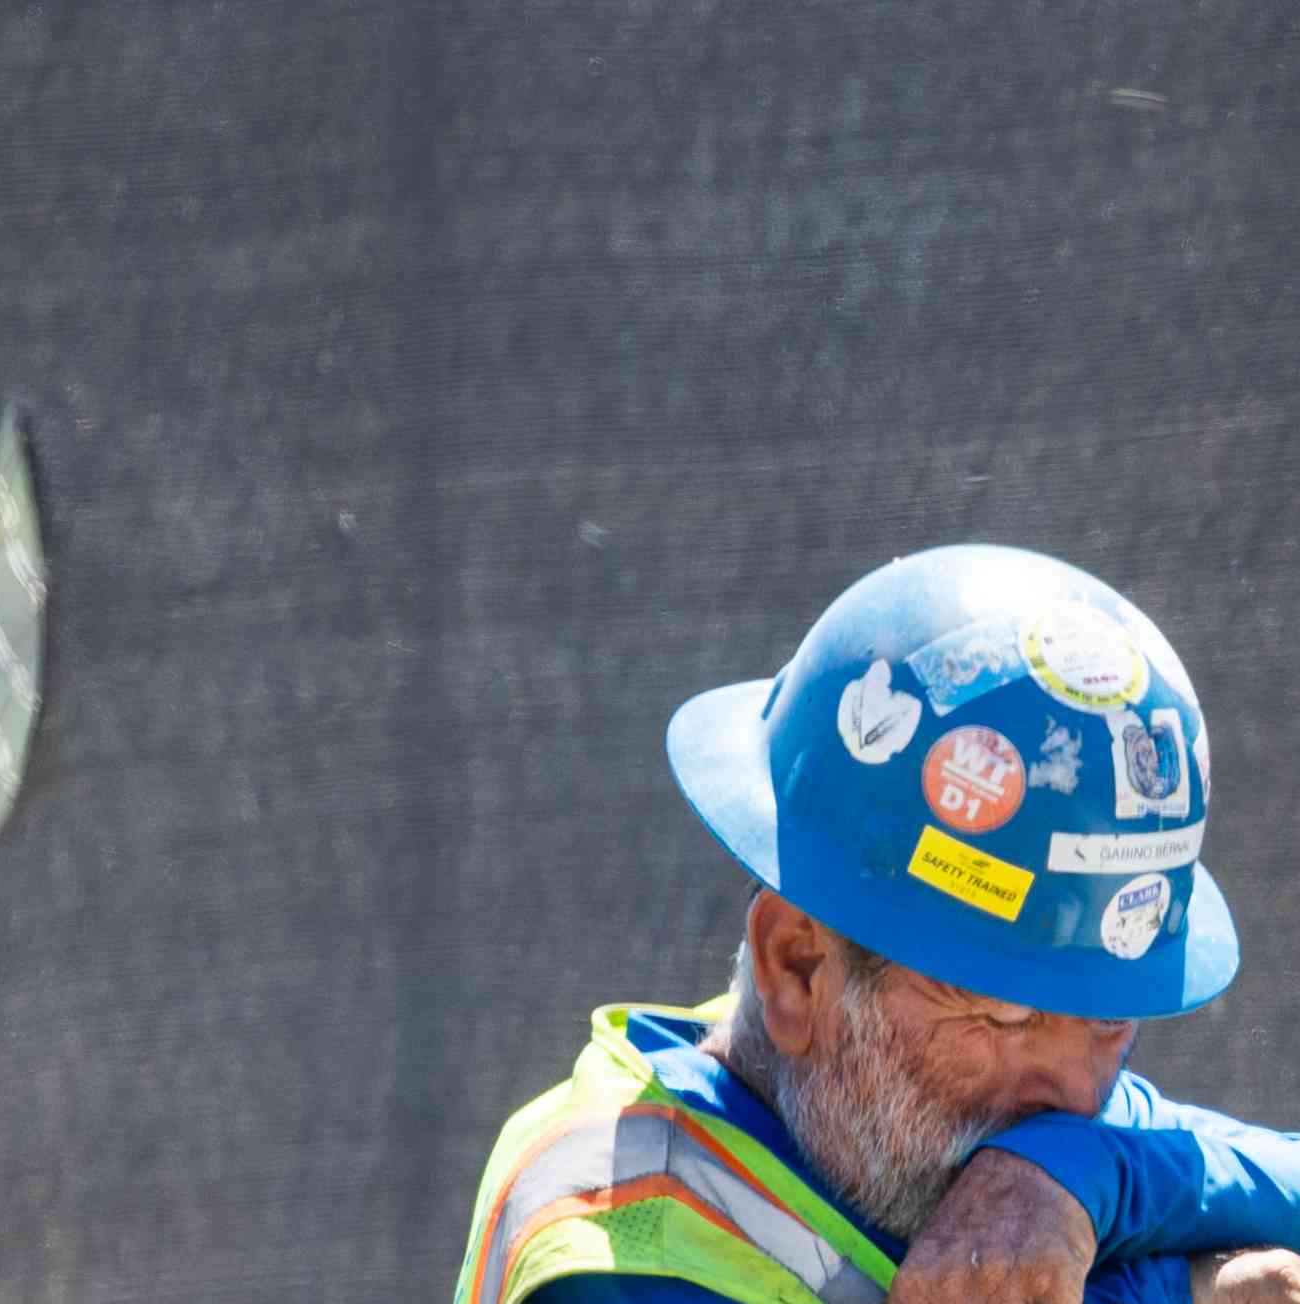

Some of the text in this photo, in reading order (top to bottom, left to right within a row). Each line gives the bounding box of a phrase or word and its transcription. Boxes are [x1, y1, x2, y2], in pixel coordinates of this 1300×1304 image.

[954, 735, 1018, 785] WT
[939, 783, 982, 821] D1
[922, 851, 963, 879] SAFETY
[967, 874, 1017, 903] TRAINED
